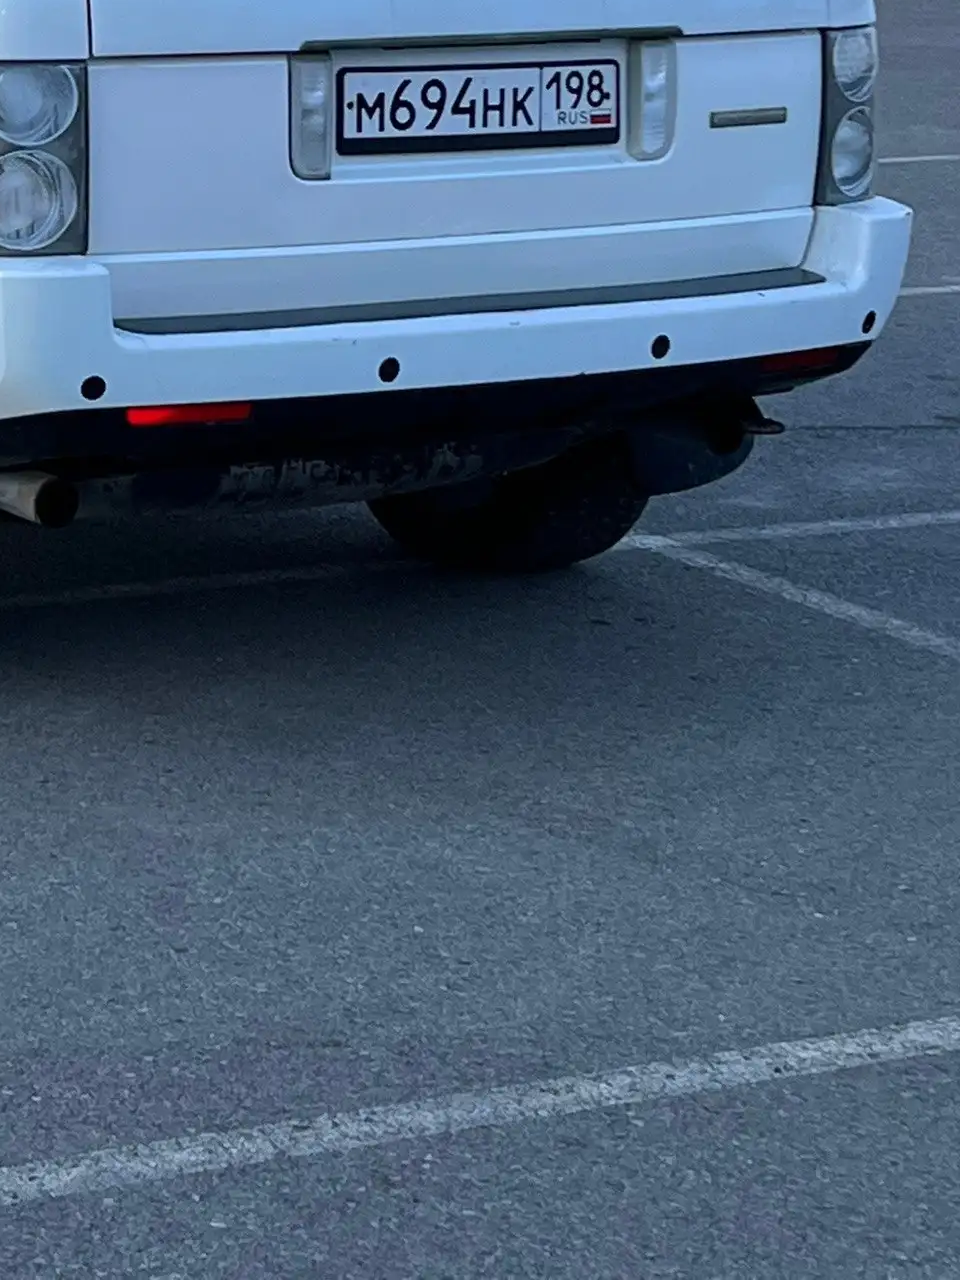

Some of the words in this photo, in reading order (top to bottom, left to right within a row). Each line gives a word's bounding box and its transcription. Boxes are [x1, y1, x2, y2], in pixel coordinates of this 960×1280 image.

[355, 77, 535, 133] М694НК
[545, 69, 605, 109] 198
[557, 110, 589, 125] RUS
